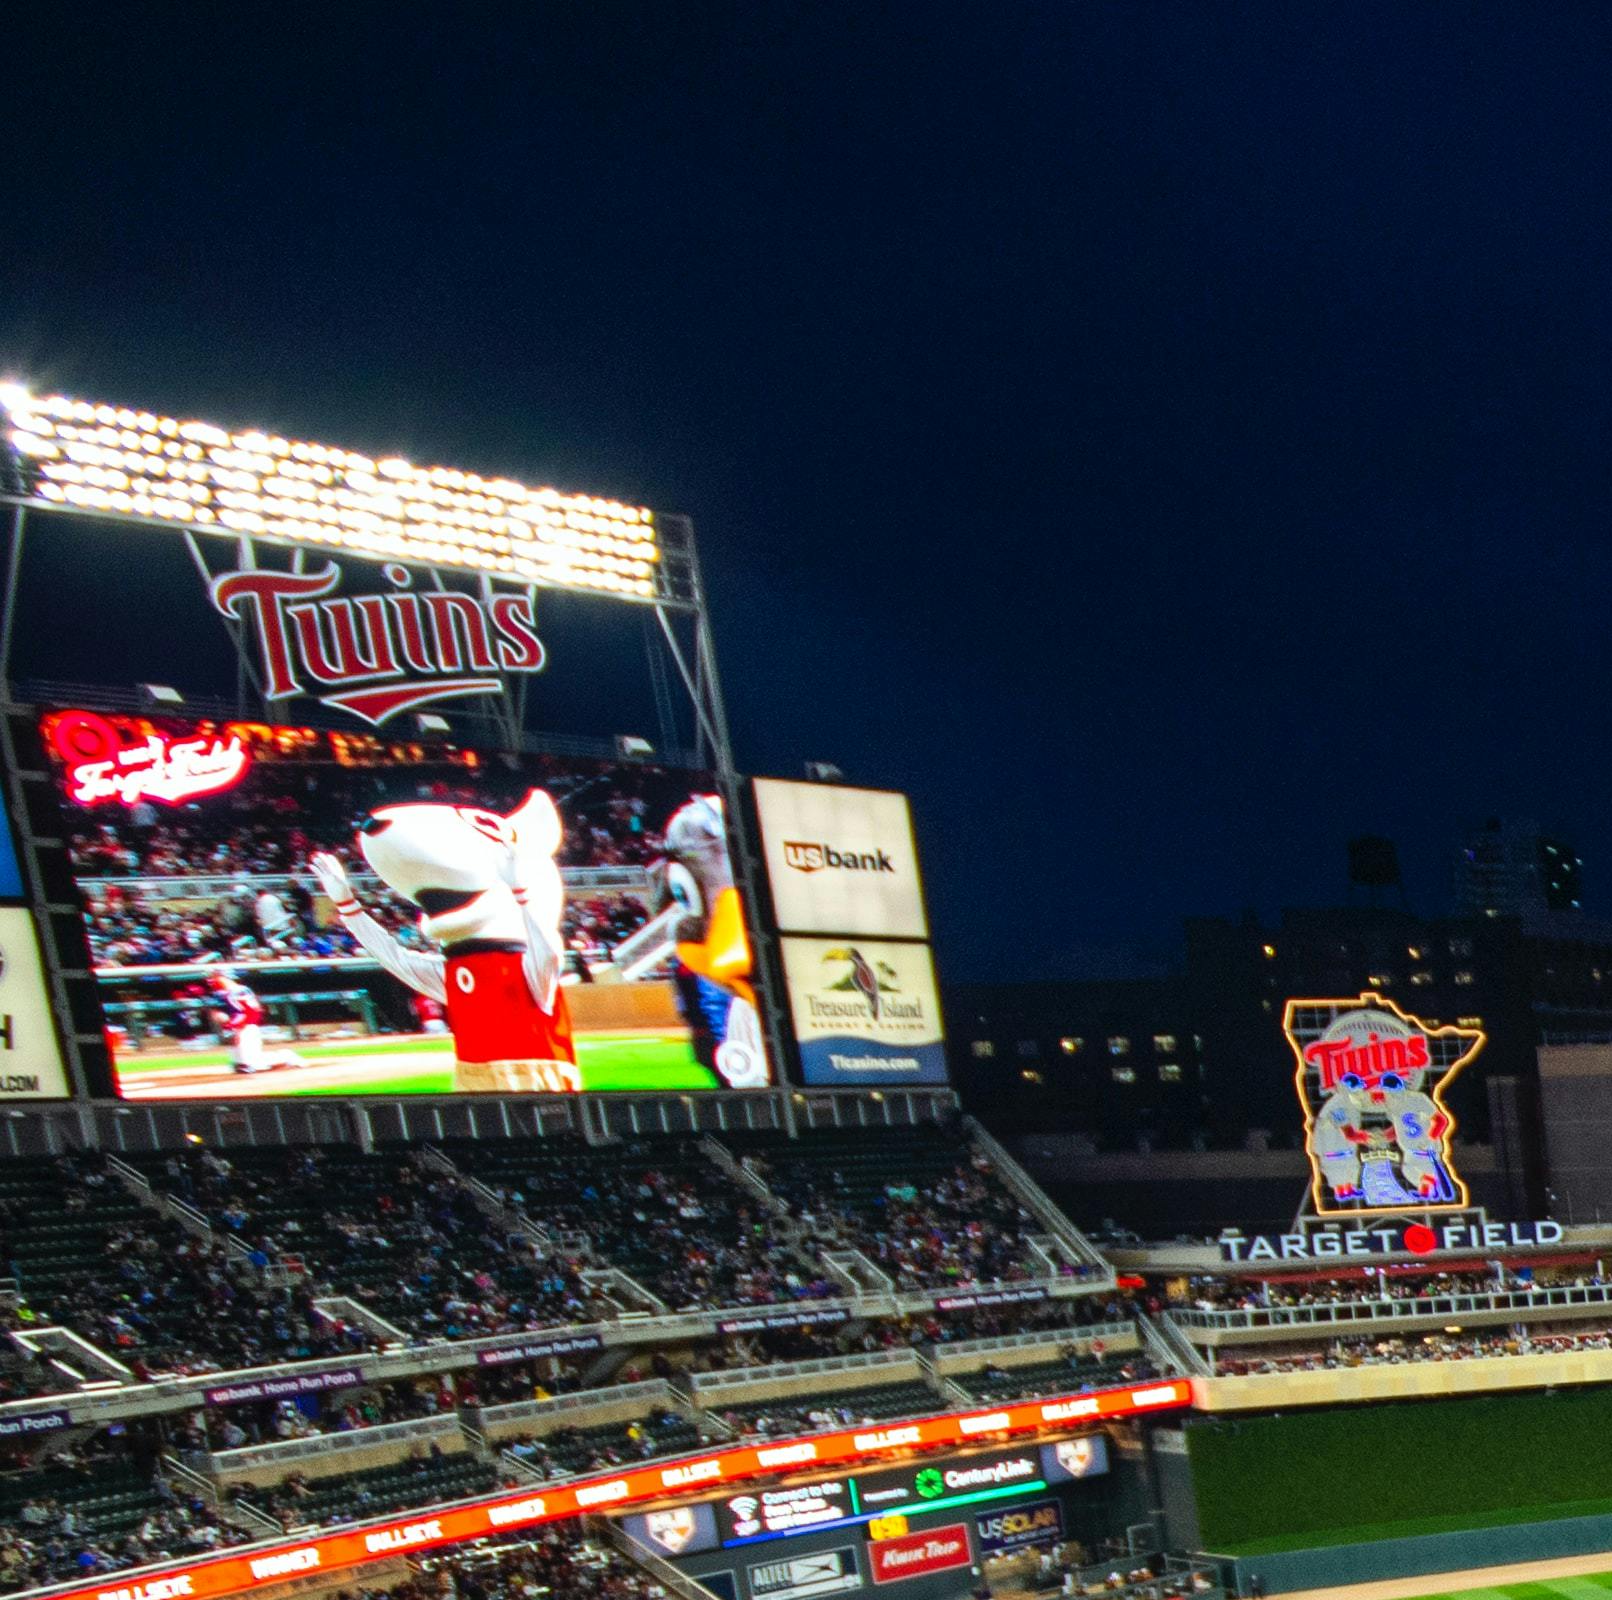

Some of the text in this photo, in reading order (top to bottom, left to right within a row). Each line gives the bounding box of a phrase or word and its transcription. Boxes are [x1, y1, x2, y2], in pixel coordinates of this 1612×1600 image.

[214, 562, 547, 725] Twins
[808, 995, 923, 1019] Treasure Island
[1304, 1032, 1430, 1095] Twins
[1220, 1220, 1564, 1261] TARGET FIELD
[265, 1379, 298, 1394] Home
[300, 1376, 322, 1391] Run
[323, 1370, 358, 1387] Porch
[23, 1414, 63, 1431] Porch
